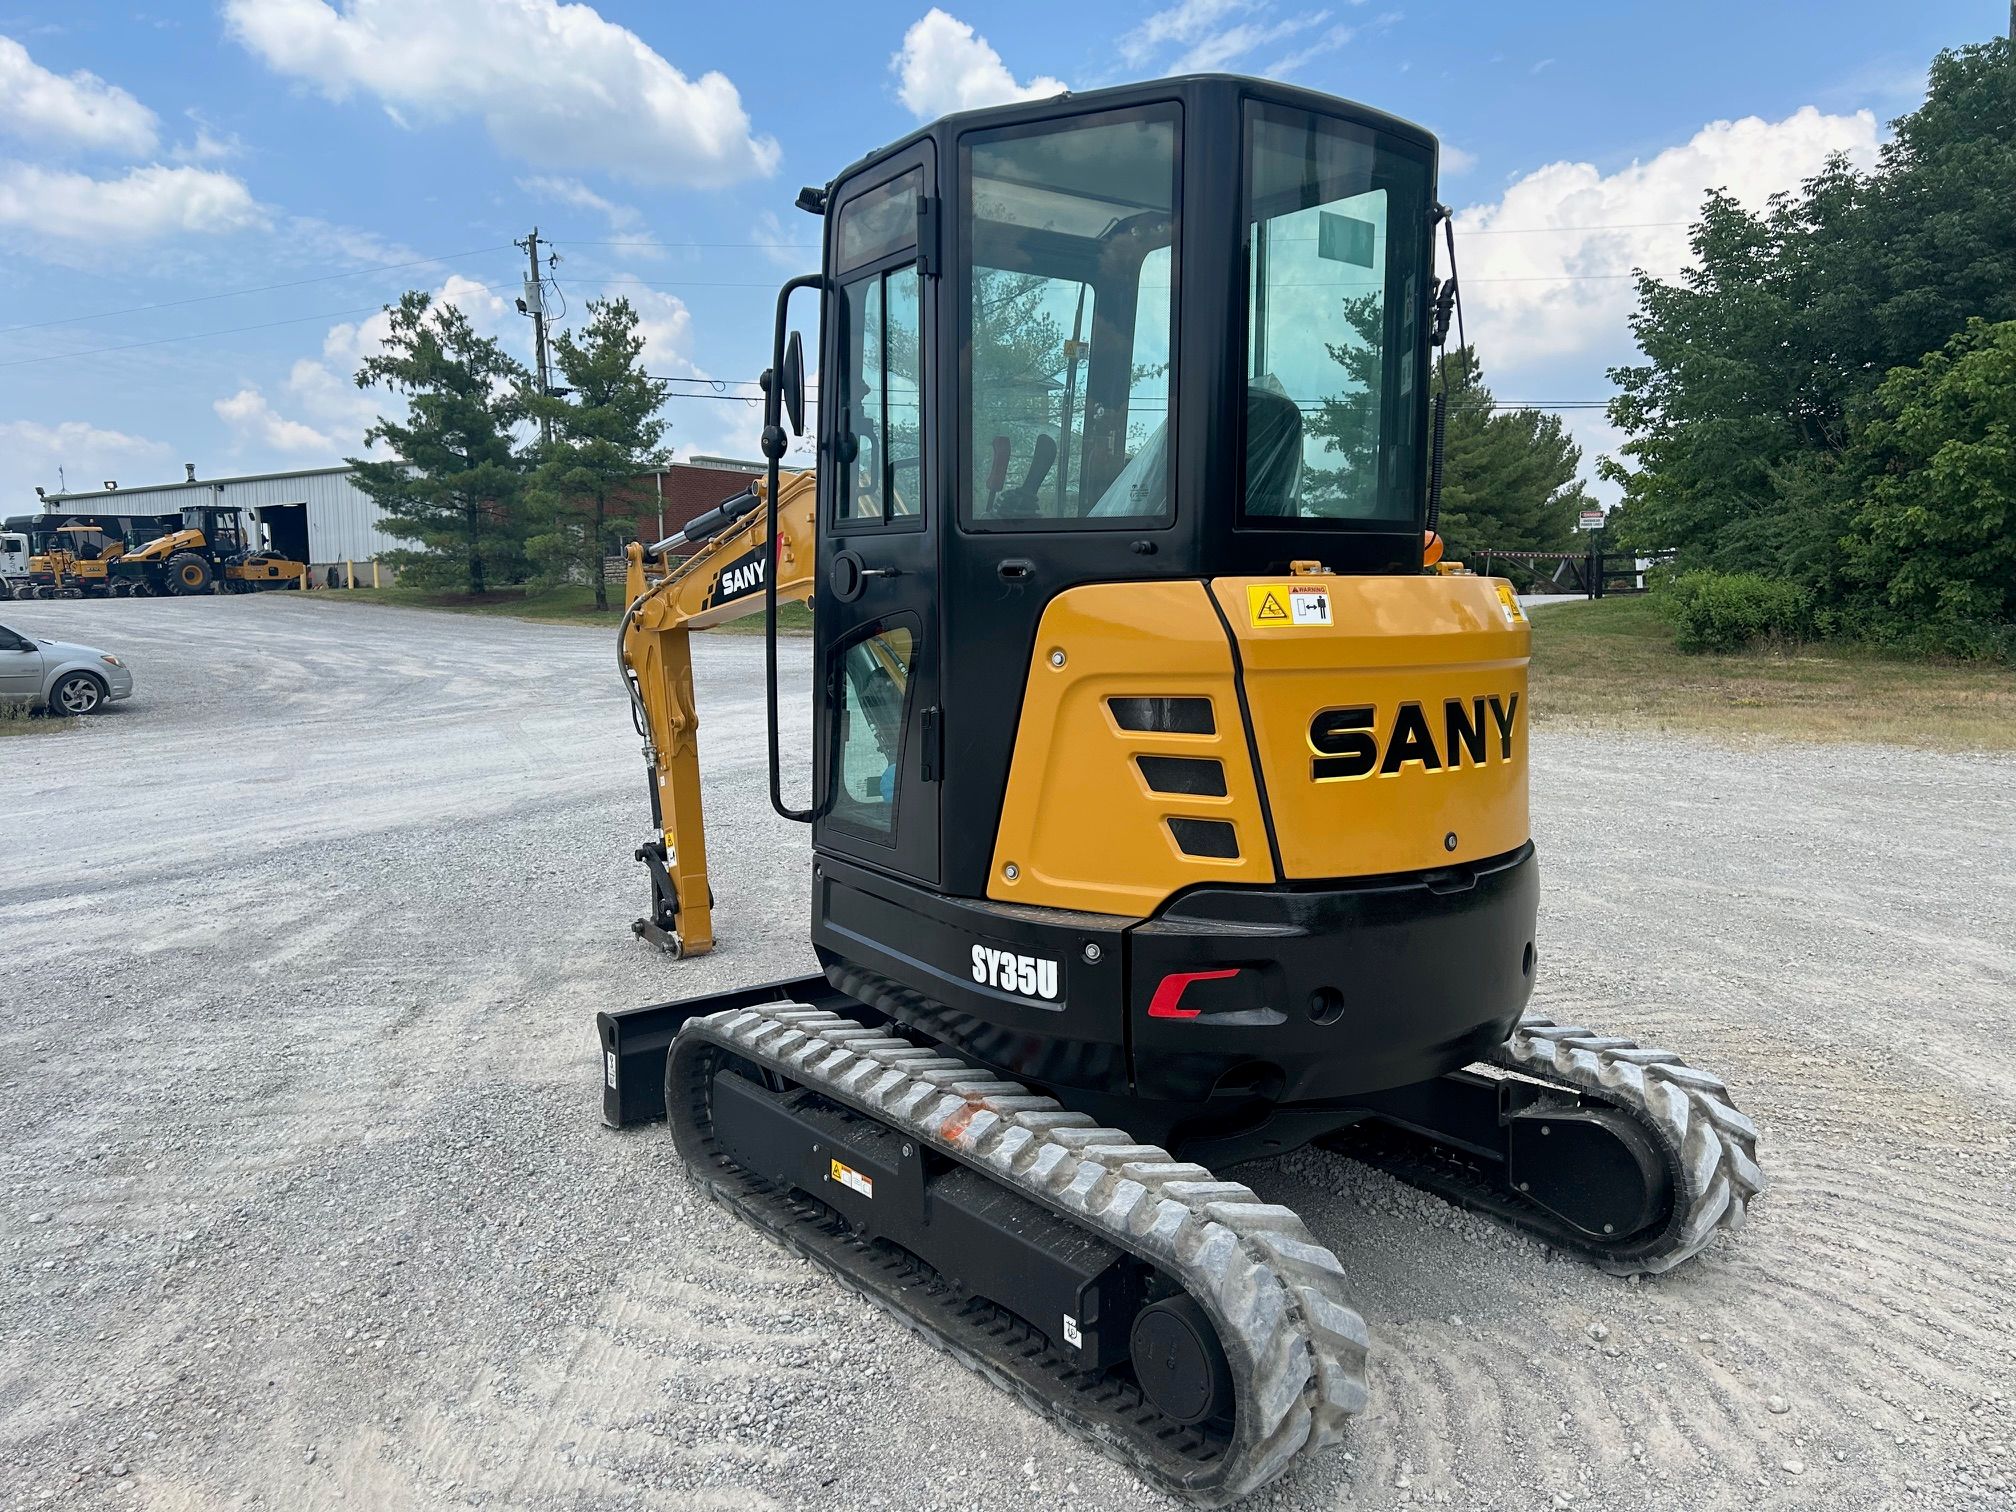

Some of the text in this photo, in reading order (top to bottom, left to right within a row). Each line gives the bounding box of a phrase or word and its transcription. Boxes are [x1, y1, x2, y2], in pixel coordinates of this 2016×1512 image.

[722, 558, 766, 596] SANY
[1305, 692, 1519, 784] SANY
[971, 944, 1058, 1000] SY35U
